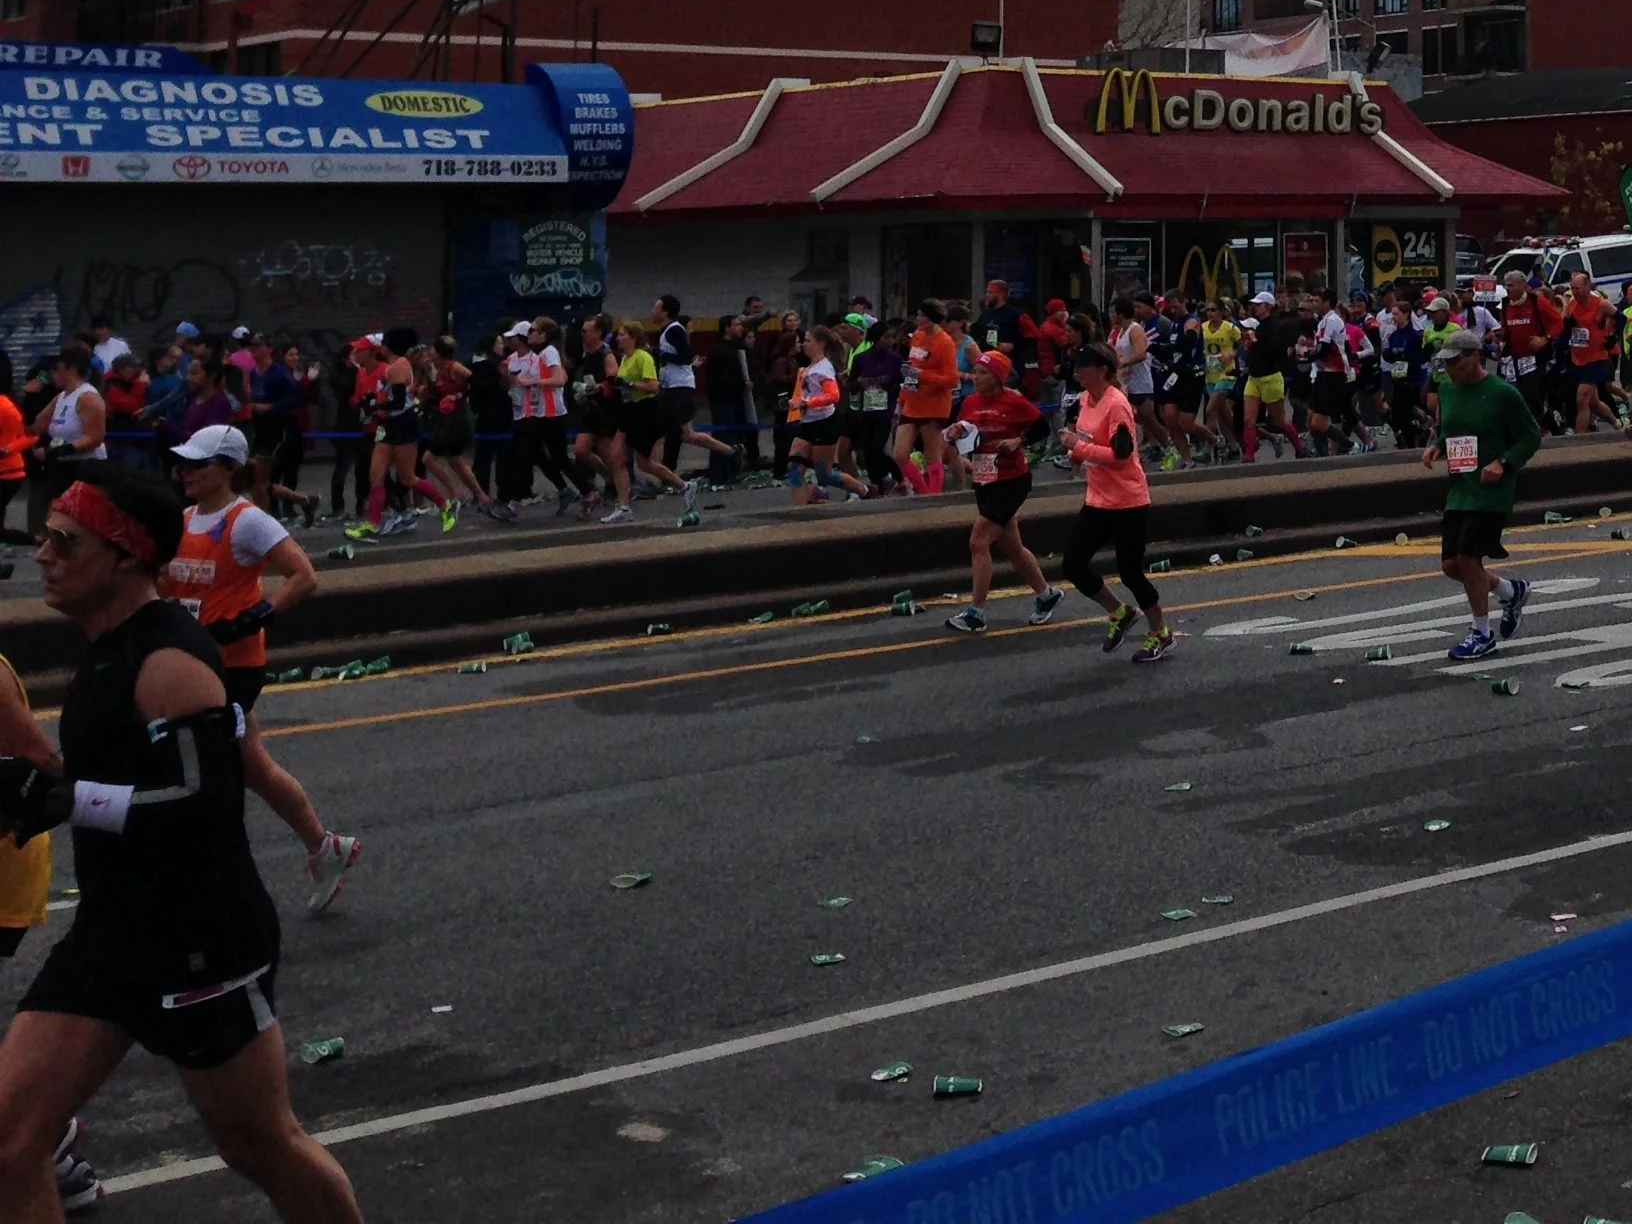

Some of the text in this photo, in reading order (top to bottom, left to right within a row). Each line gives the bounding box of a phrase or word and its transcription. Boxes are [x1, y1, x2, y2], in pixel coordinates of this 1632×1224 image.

[0, 43, 162, 68] REPAIR
[23, 76, 325, 107] DIAGNOSIS
[576, 92, 611, 105] TIRES
[380, 94, 471, 114] DOMESTIC
[574, 106, 618, 119] BRAKES
[86, 105, 108, 121] &
[120, 106, 263, 123] SERVICE
[146, 124, 491, 150] SPECIALIST
[568, 122, 626, 135] MUFFLERS
[573, 139, 623, 152] WELDING
[217, 159, 290, 175] TOYOTA
[422, 158, 557, 177] 718-788-0233
[522, 219, 586, 243] REGISTERED
[527, 256, 584, 266] REPAIR SHOP
[1211, 959, 1620, 1158] POLICE LINE DO NOT CROSS
[968, 1155, 1038, 1224] NOT
[1048, 1119, 1167, 1217] CROSS
